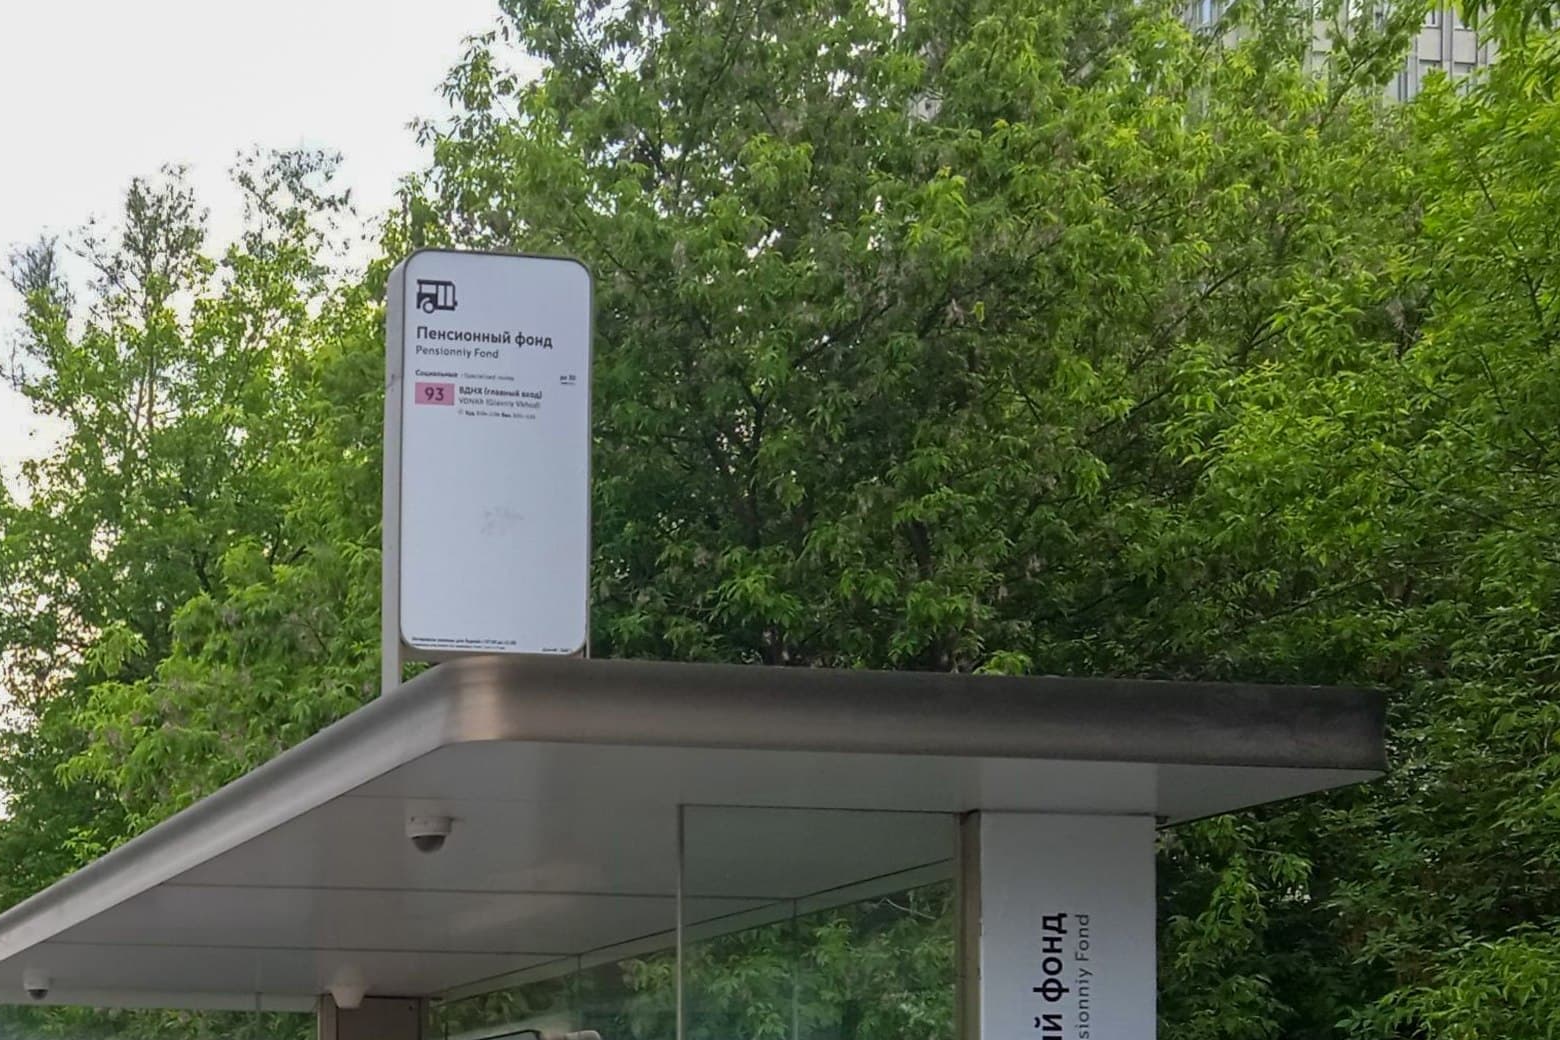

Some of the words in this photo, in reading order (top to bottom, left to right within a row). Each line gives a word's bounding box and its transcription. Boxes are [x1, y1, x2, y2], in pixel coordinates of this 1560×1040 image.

[416, 326, 511, 344] Пенсионный
[515, 331, 553, 349] фонд
[415, 345, 471, 358] Pensionniy
[474, 348, 499, 359] Fond
[424, 387, 445, 401] 93
[1075, 914, 1090, 961] Fond
[1033, 913, 1070, 1003] фонд
